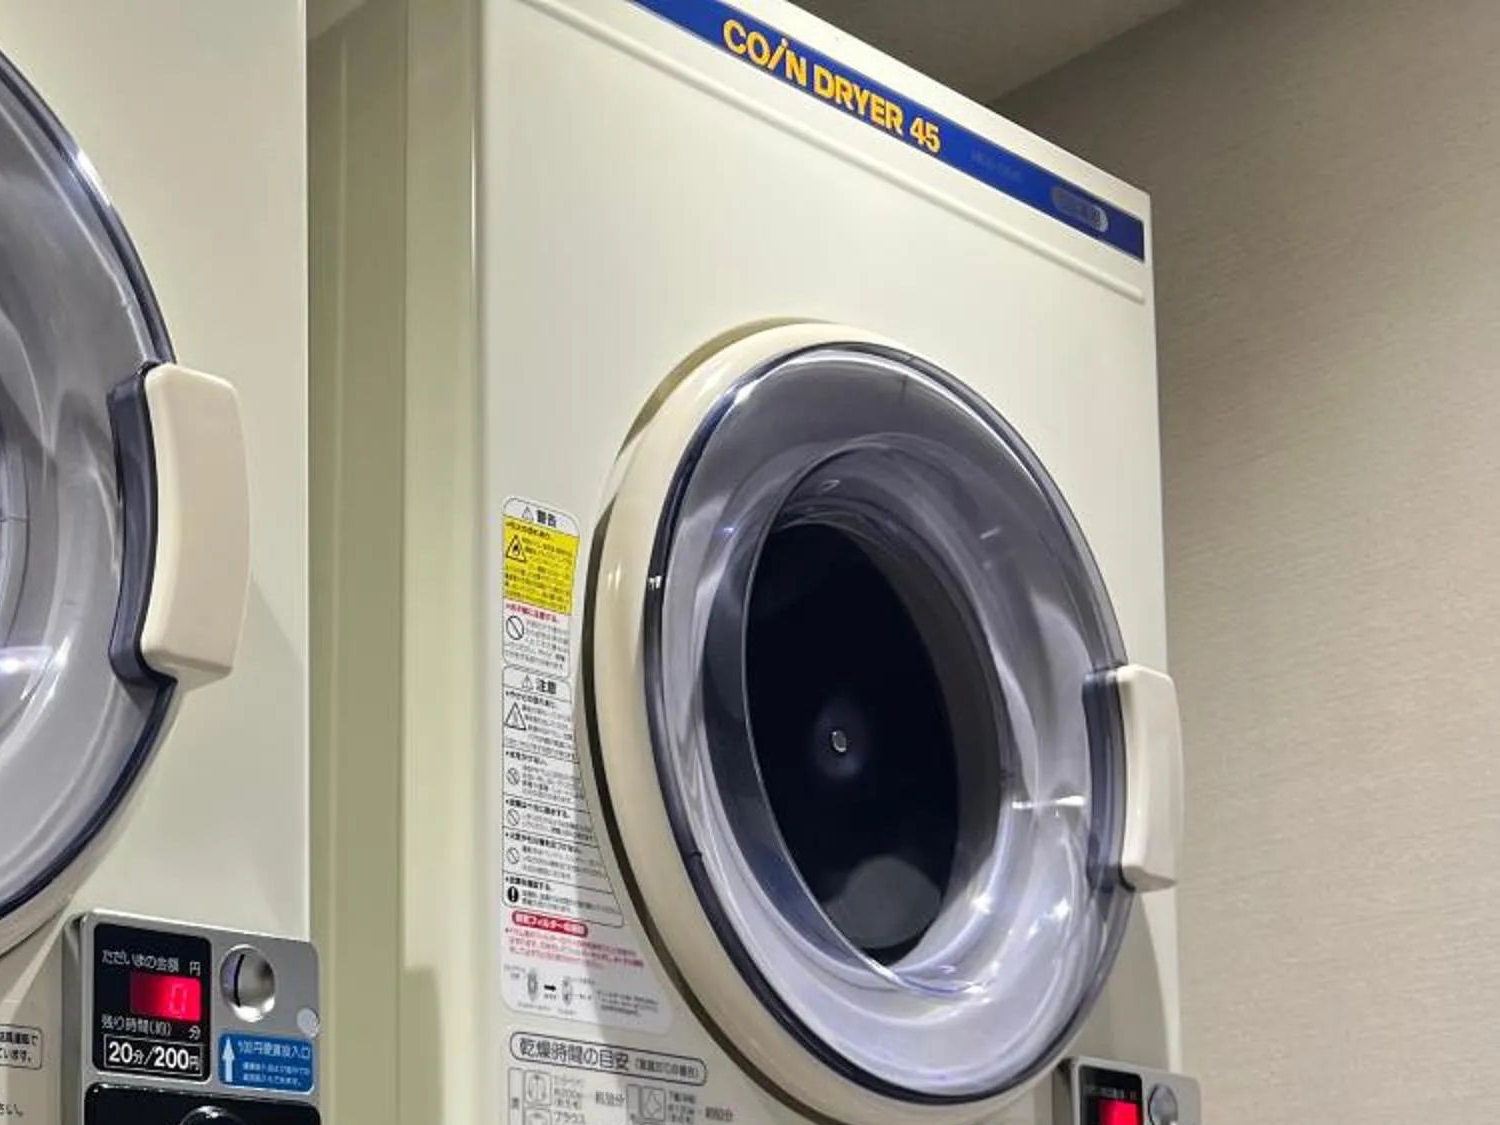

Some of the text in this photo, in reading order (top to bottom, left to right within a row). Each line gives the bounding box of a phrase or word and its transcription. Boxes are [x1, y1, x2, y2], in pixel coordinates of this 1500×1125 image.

[812, 63, 904, 136] DRYER
[909, 117, 941, 153] 45
[168, 982, 188, 1016] 0
